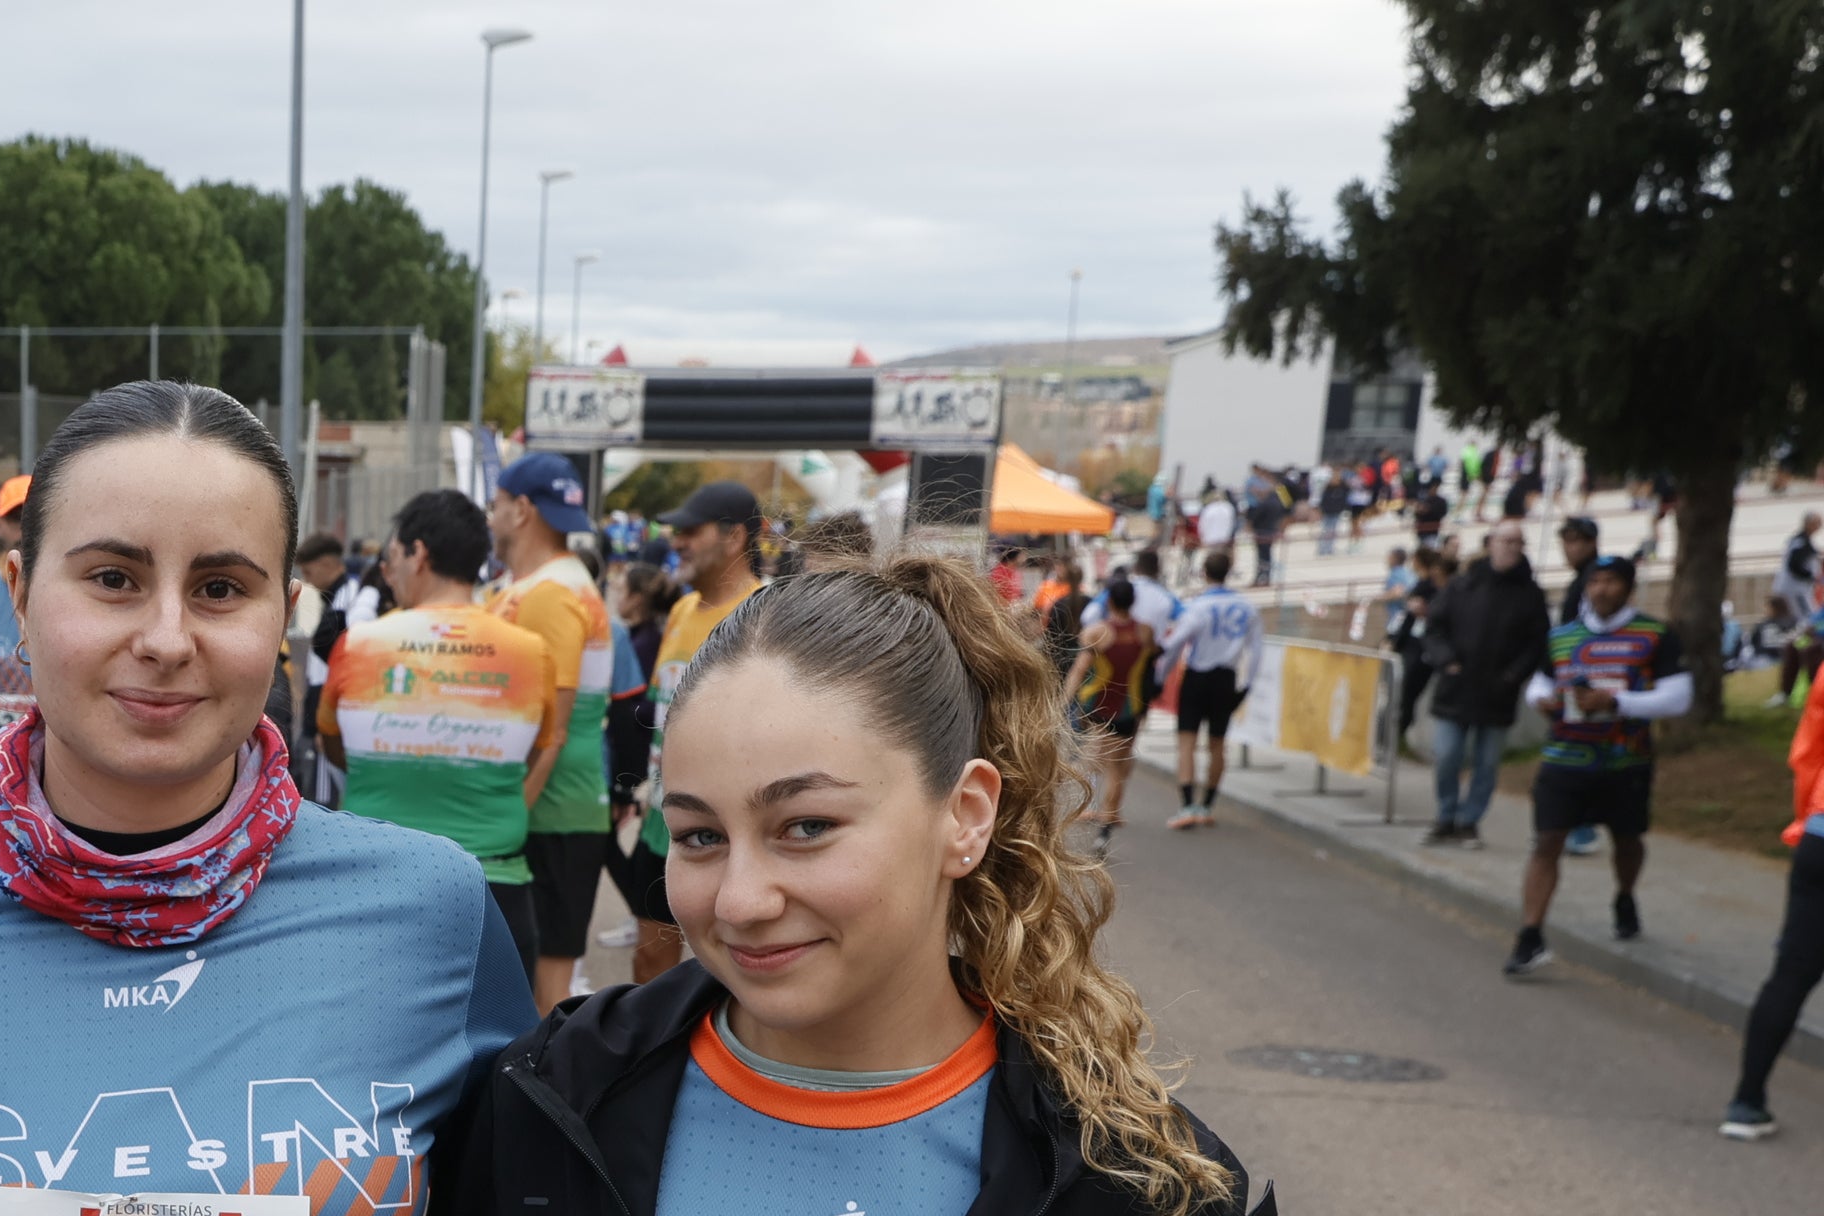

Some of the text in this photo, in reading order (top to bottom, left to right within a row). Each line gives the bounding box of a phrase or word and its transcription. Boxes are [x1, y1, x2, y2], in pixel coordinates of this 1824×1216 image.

[1211, 603, 1249, 640] 13
[398, 640, 495, 657] JAVI RAMOS
[103, 984, 170, 1009] MKA
